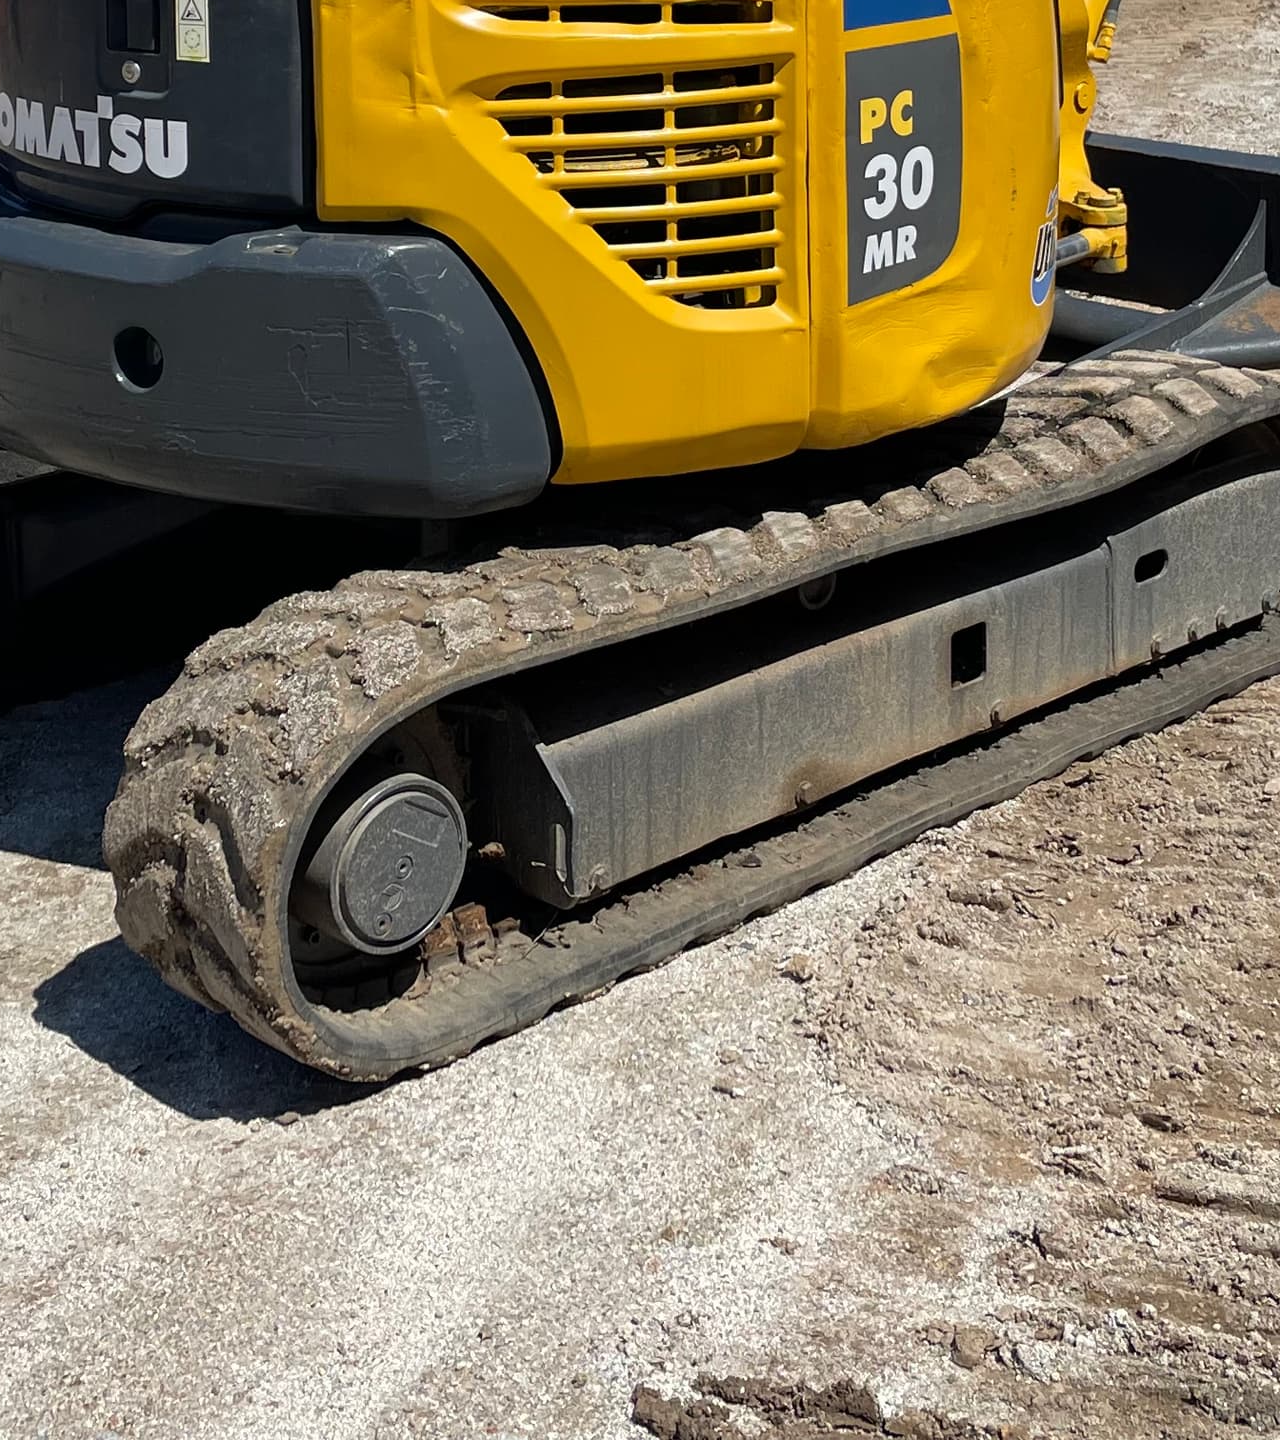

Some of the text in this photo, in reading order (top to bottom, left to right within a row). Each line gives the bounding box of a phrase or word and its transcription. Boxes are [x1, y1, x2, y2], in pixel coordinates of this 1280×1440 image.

[860, 90, 913, 145] PC
[863, 145, 934, 220] 30
[863, 225, 918, 274] MR
